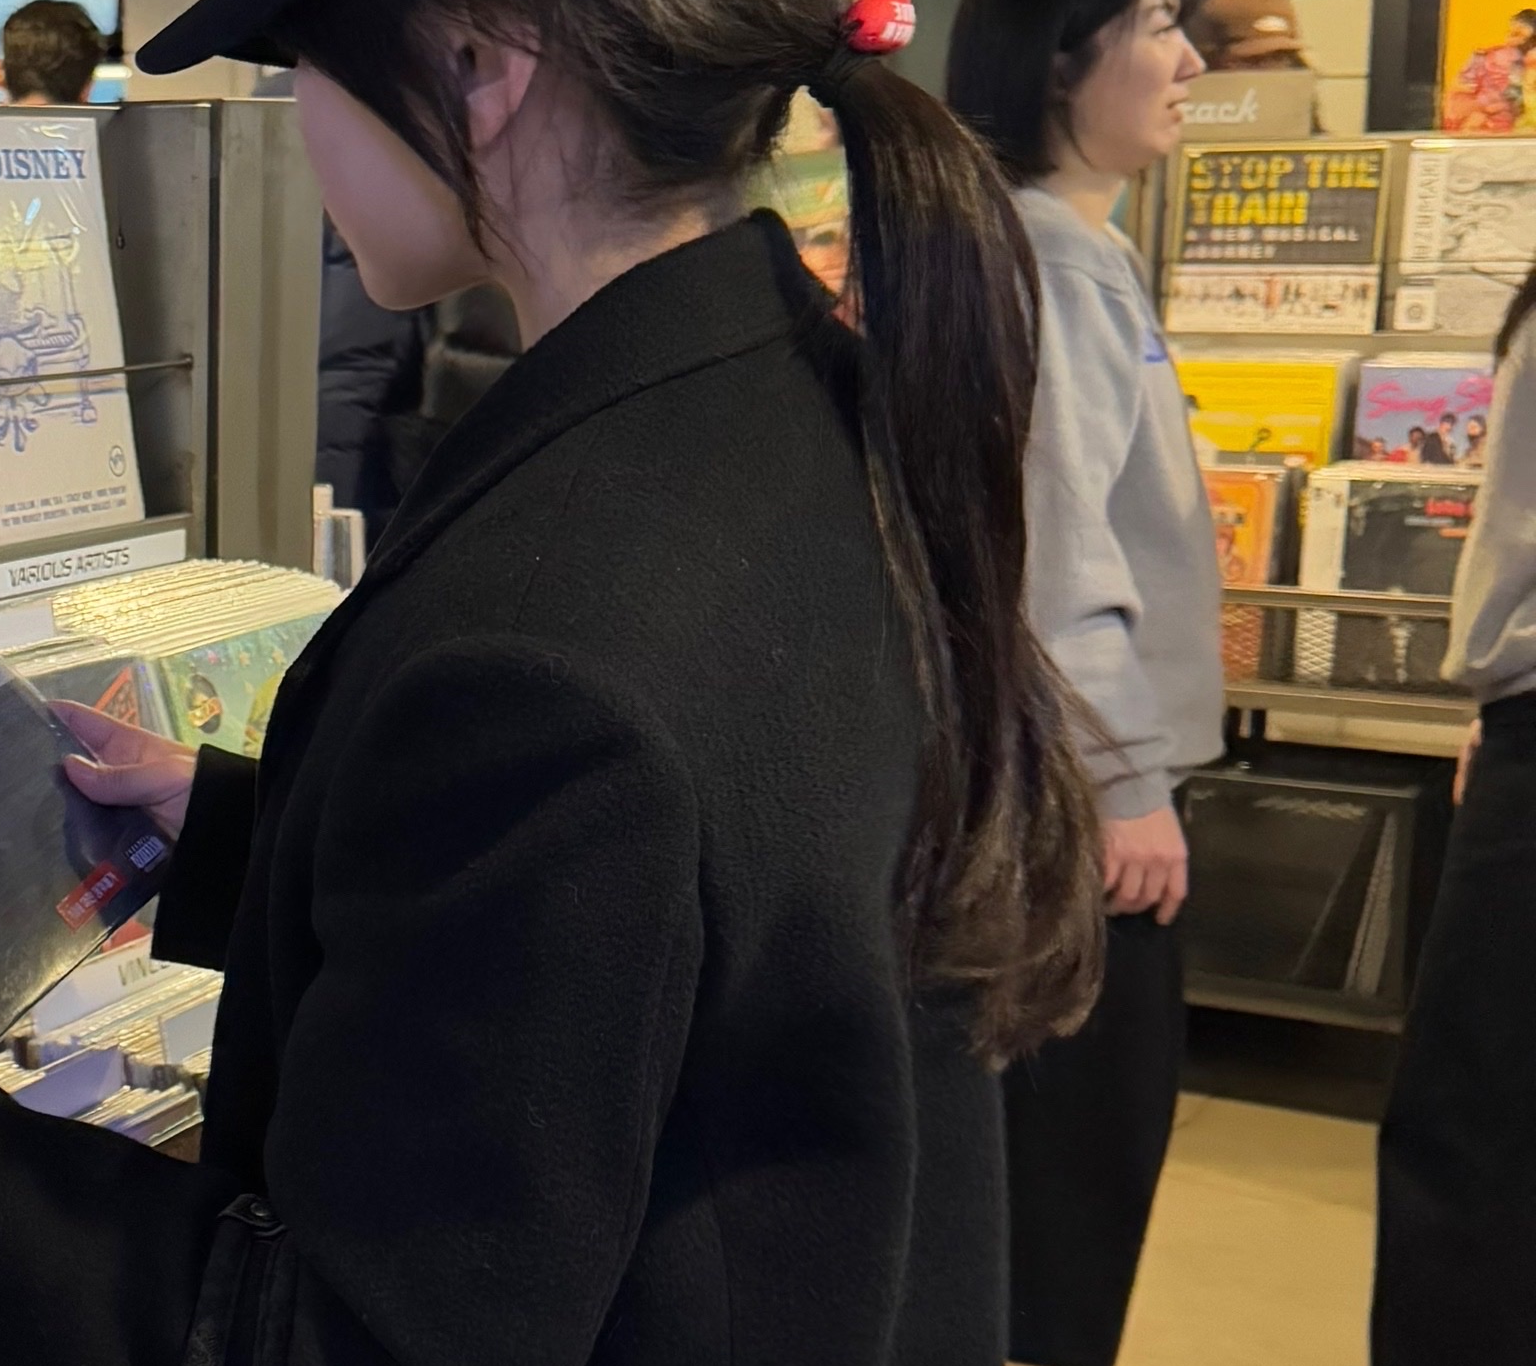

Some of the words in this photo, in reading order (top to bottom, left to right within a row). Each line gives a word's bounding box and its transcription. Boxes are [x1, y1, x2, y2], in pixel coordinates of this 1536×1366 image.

[1190, 154, 1295, 189] STOP
[1304, 153, 1380, 188] THE
[1190, 190, 1309, 225] TRAIN
[9, 552, 72, 588] VARIOUS
[74, 546, 131, 576] ARTISTS
